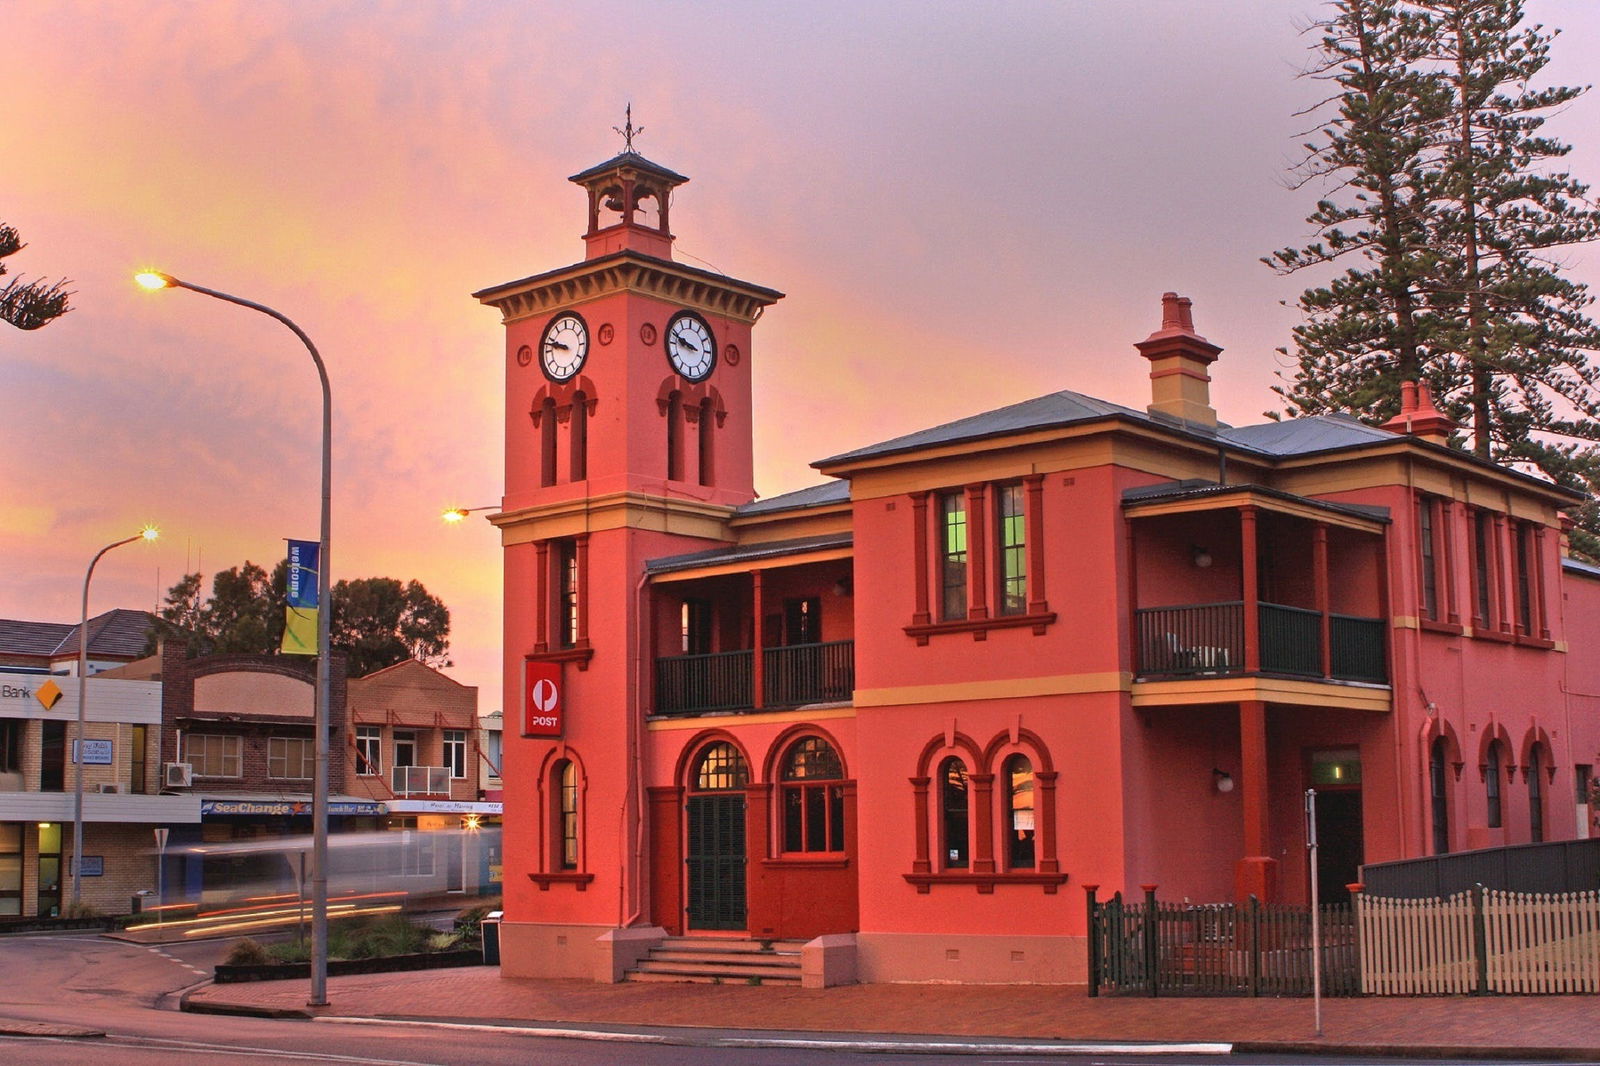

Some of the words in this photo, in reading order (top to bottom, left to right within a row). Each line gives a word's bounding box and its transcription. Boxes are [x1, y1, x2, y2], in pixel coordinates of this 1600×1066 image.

[291, 546, 300, 598] welcome
[3, 685, 31, 698] Bank
[532, 716, 557, 727] POST
[214, 802, 290, 815] SeaChange
